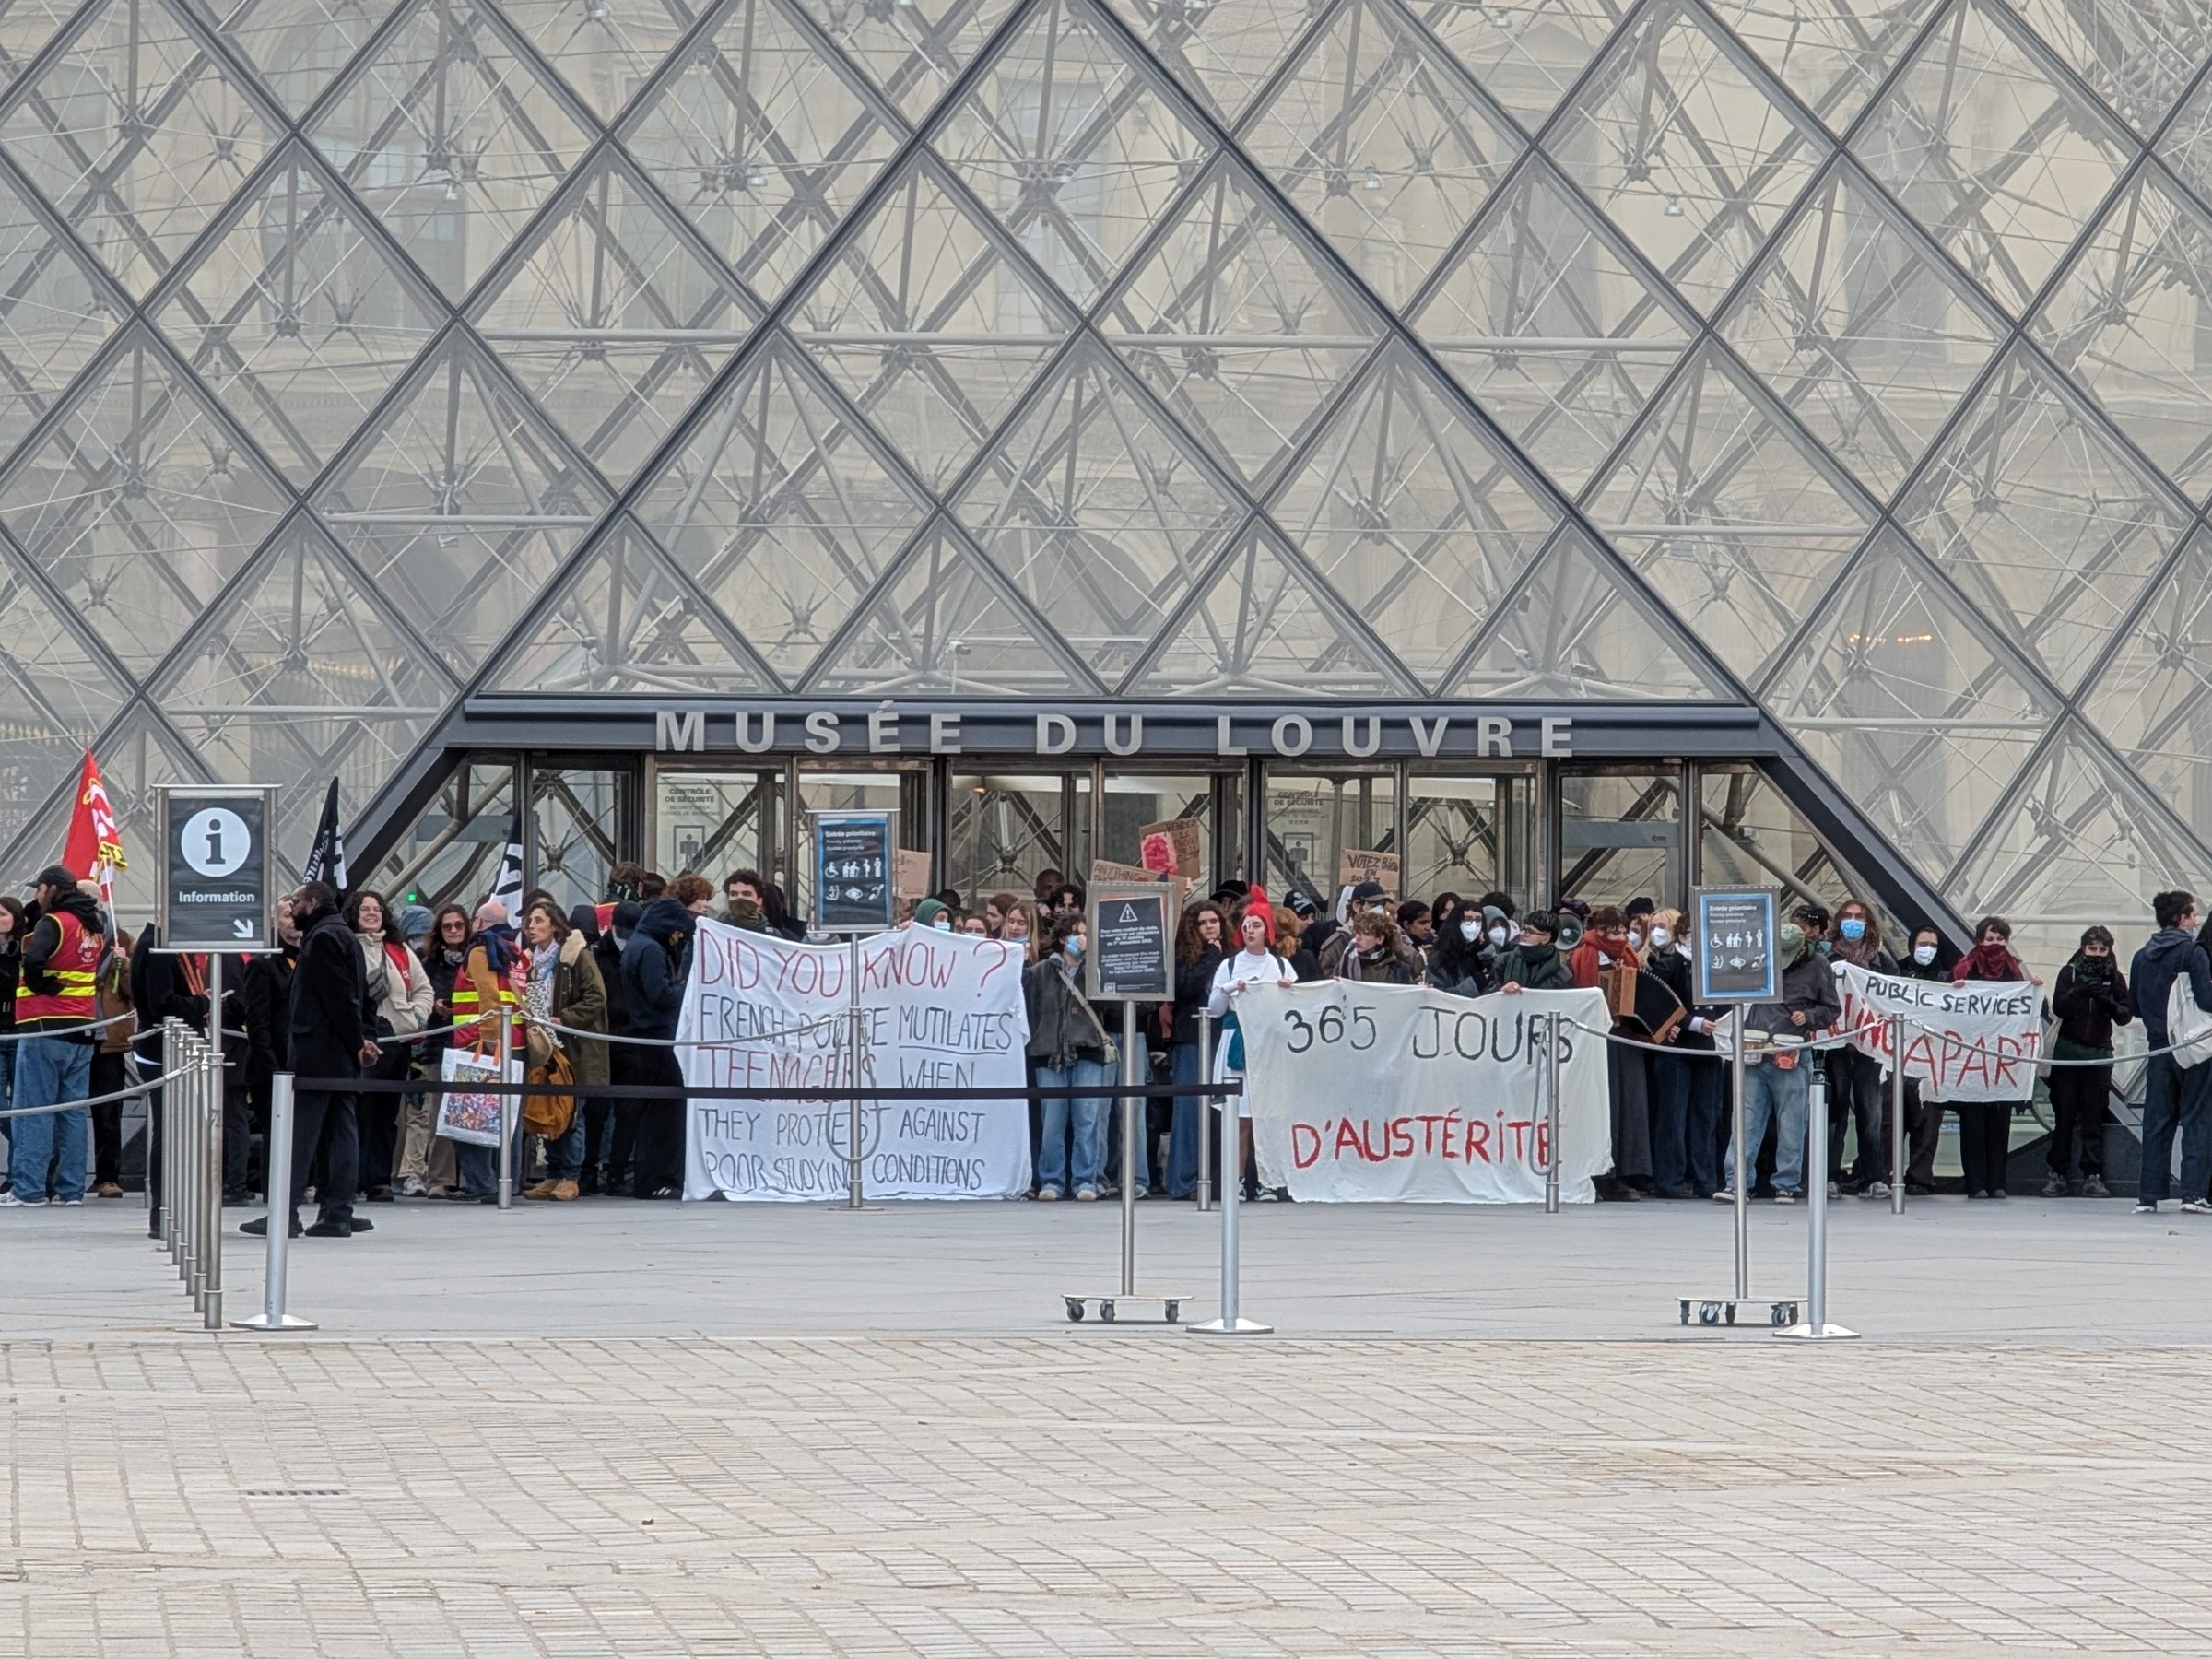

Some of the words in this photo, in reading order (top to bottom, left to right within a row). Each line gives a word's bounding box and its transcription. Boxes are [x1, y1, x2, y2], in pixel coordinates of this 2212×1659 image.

[655, 700, 962, 754] MUSÉE
[1036, 713, 1143, 755] DU
[1217, 714, 1573, 758] LOUVRE
[1347, 854, 1381, 869] VOTEZ
[179, 891, 255, 902] Information
[700, 928, 759, 989] DID
[772, 948, 845, 998] YOU
[861, 942, 957, 993] KNOW
[700, 993, 786, 1047] FRENCH
[898, 1004, 1014, 1052] MUTILATES
[1284, 1005, 1377, 1053] 365
[900, 1056, 975, 1090] WHEN
[1902, 1030, 2040, 1097] APART
[698, 1108, 761, 1142] THEY
[898, 1106, 986, 1144] AGAINST
[705, 1150, 770, 1191] POOR
[871, 1153, 986, 1191] CONDITIONS
